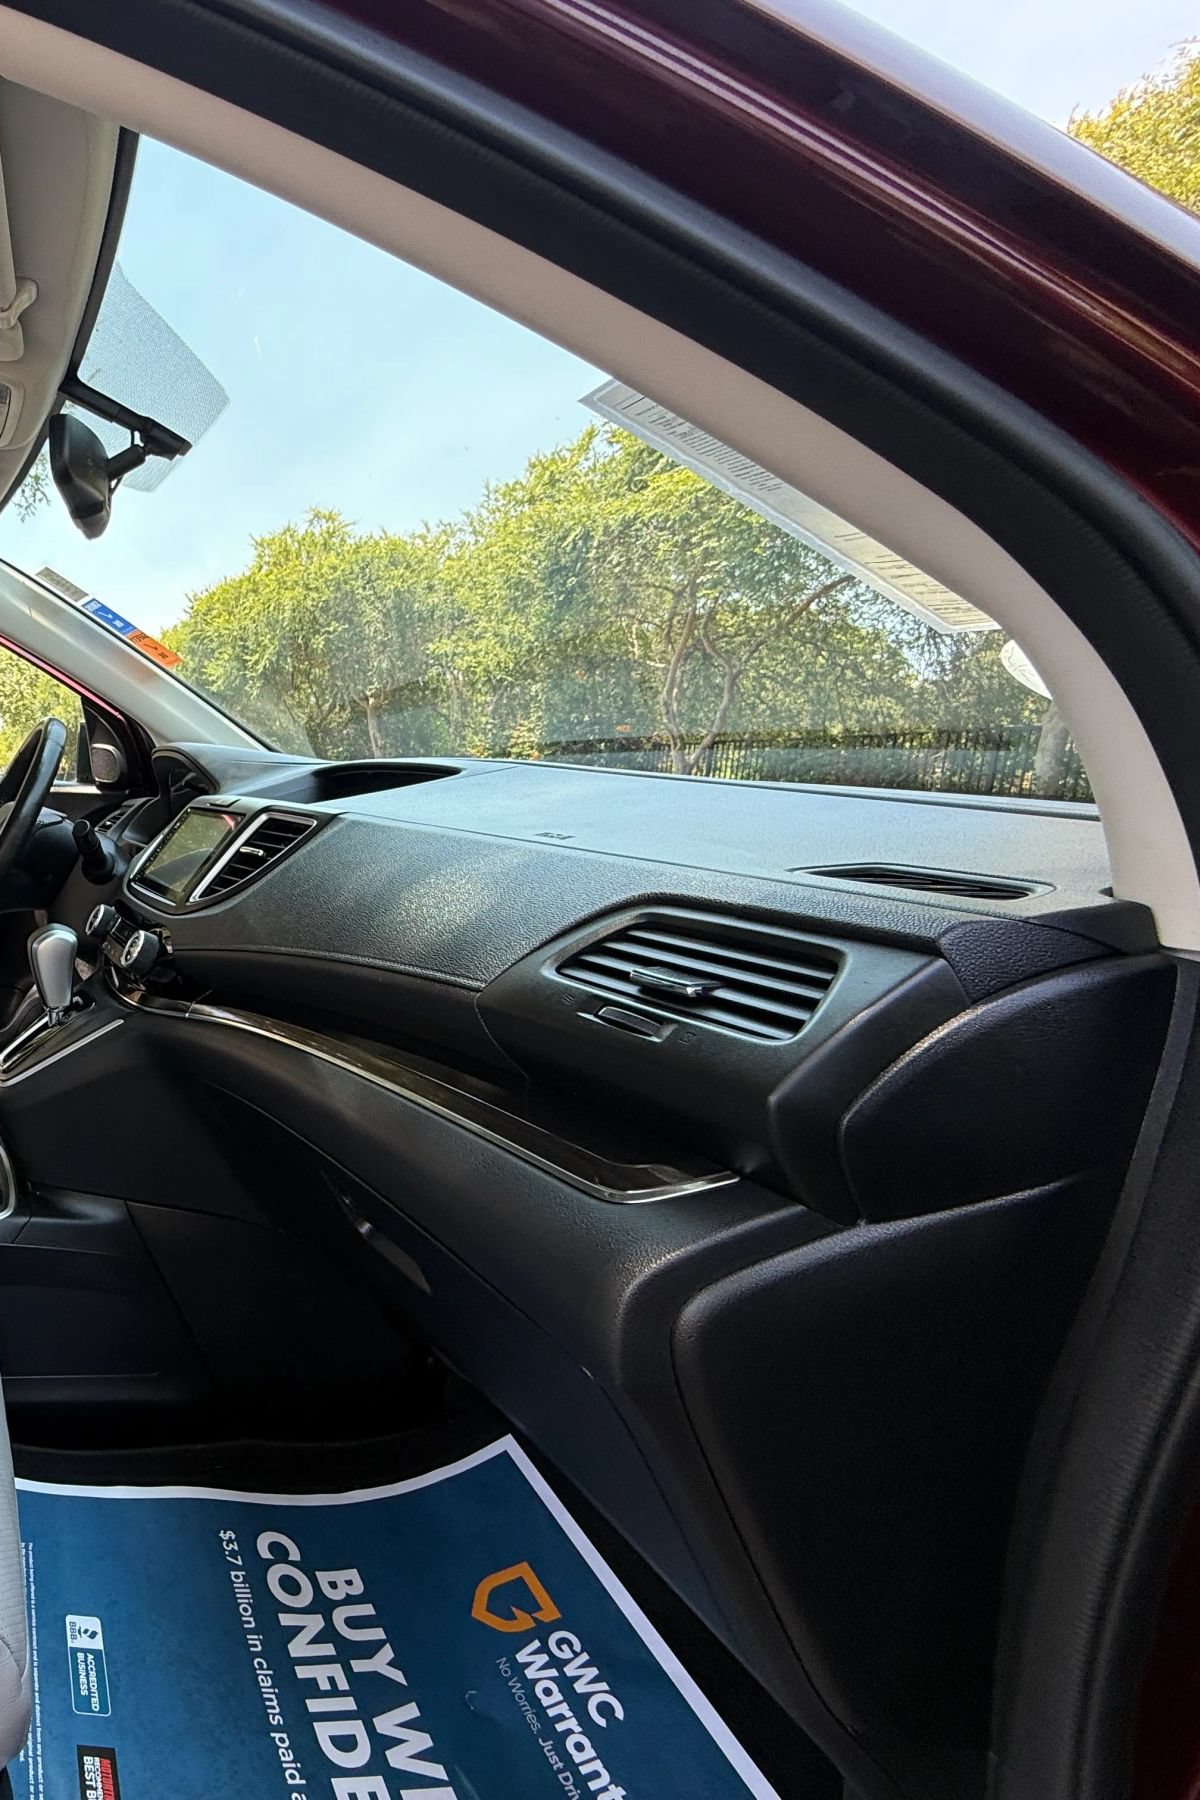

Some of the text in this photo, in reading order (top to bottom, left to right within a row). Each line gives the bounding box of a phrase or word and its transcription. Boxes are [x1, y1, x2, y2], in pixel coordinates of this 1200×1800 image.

[218, 1529, 243, 1567] $3.7
[230, 1570, 256, 1629] billion
[314, 1568, 408, 1687] BUY
[246, 1634, 264, 1652] in
[256, 1531, 392, 1800] CONFIDE
[76, 1652, 88, 1696] BUSINESS
[86, 1652, 100, 1712] ACCREDITED
[253, 1657, 284, 1726] claims
[547, 1630, 625, 1728] GWC
[496, 1657, 512, 1677] No
[508, 1677, 541, 1734] Worries.
[538, 1737, 565, 1771] Just
[83, 1756, 96, 1788] BEST
[270, 1731, 307, 1785] paid
